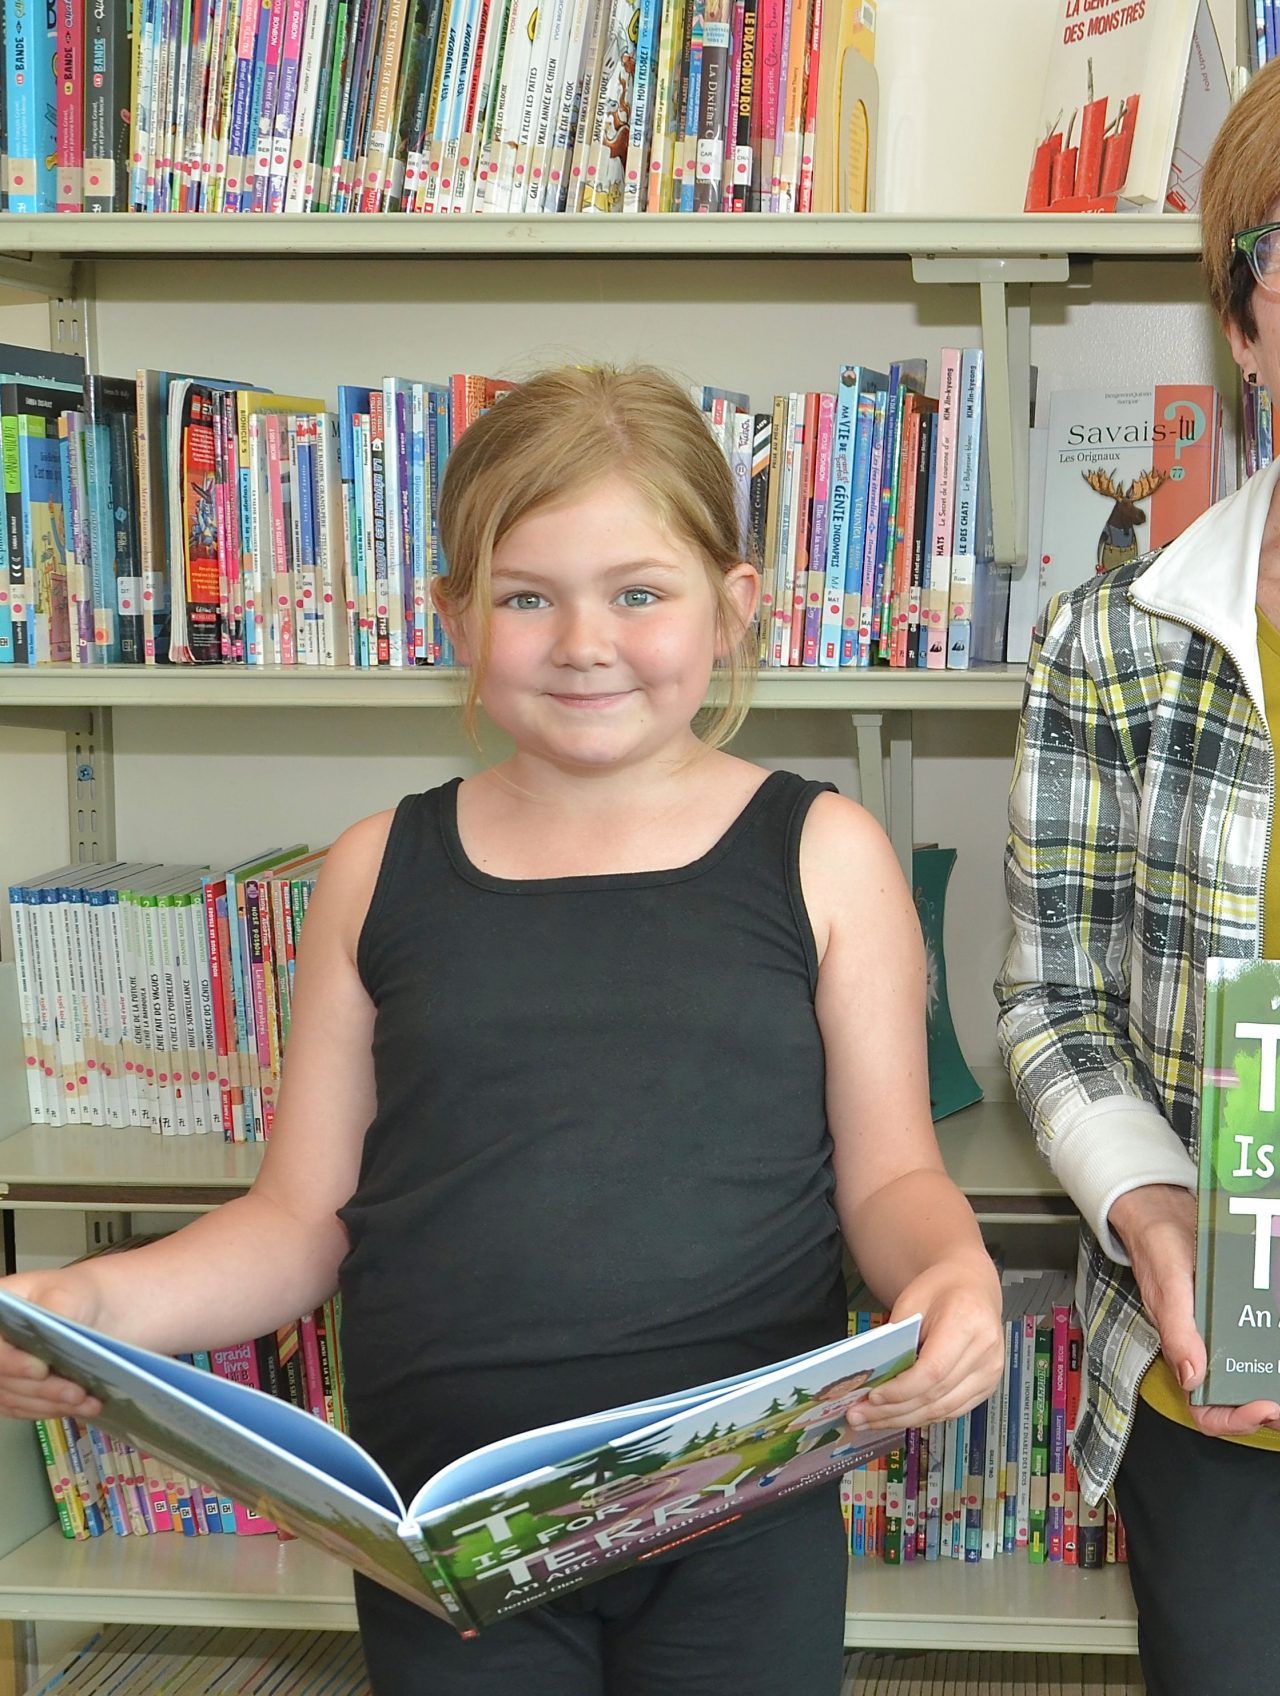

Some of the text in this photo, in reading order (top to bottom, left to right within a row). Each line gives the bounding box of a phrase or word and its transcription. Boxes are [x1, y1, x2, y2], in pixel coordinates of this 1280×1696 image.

[290, 10, 299, 41] BONBON
[1064, 22, 1085, 45] DES
[1087, 1, 1147, 36] MONSTRES
[15, 37, 26, 71] BANDE
[64, 47, 75, 80] BANDE
[739, 12, 756, 117] LE DRAGON DU ROI
[376, 19, 397, 131] ENTURES DE TOUS LES
[528, 67, 537, 92] PATTES
[838, 420, 850, 441] VIE
[838, 443, 848, 456] DE
[959, 364, 977, 542] DES CHATS KIM Jin-kyeong
[1060, 451, 1120, 465] Les Orignaux
[373, 458, 387, 580] LA RÉVOLTE DES ROBOTS
[832, 485, 848, 523] GÉNIE
[830, 524, 841, 568] INCOMPRIS
[151, 974, 163, 1032] FAIT DES VAGUES
[1237, 1304, 1271, 1329] An
[215, 1347, 251, 1364] grand
[223, 1361, 250, 1374] livre
[1225, 1358, 1273, 1375] Denise
[1024, 1381, 1032, 1411] L'HOMME
[1022, 1433, 1030, 1457] DIABLE
[1021, 1458, 1029, 1470] DES
[452, 1501, 529, 1544] T
[476, 1465, 757, 1586] TERRY
[546, 1558, 598, 1583] ABC
